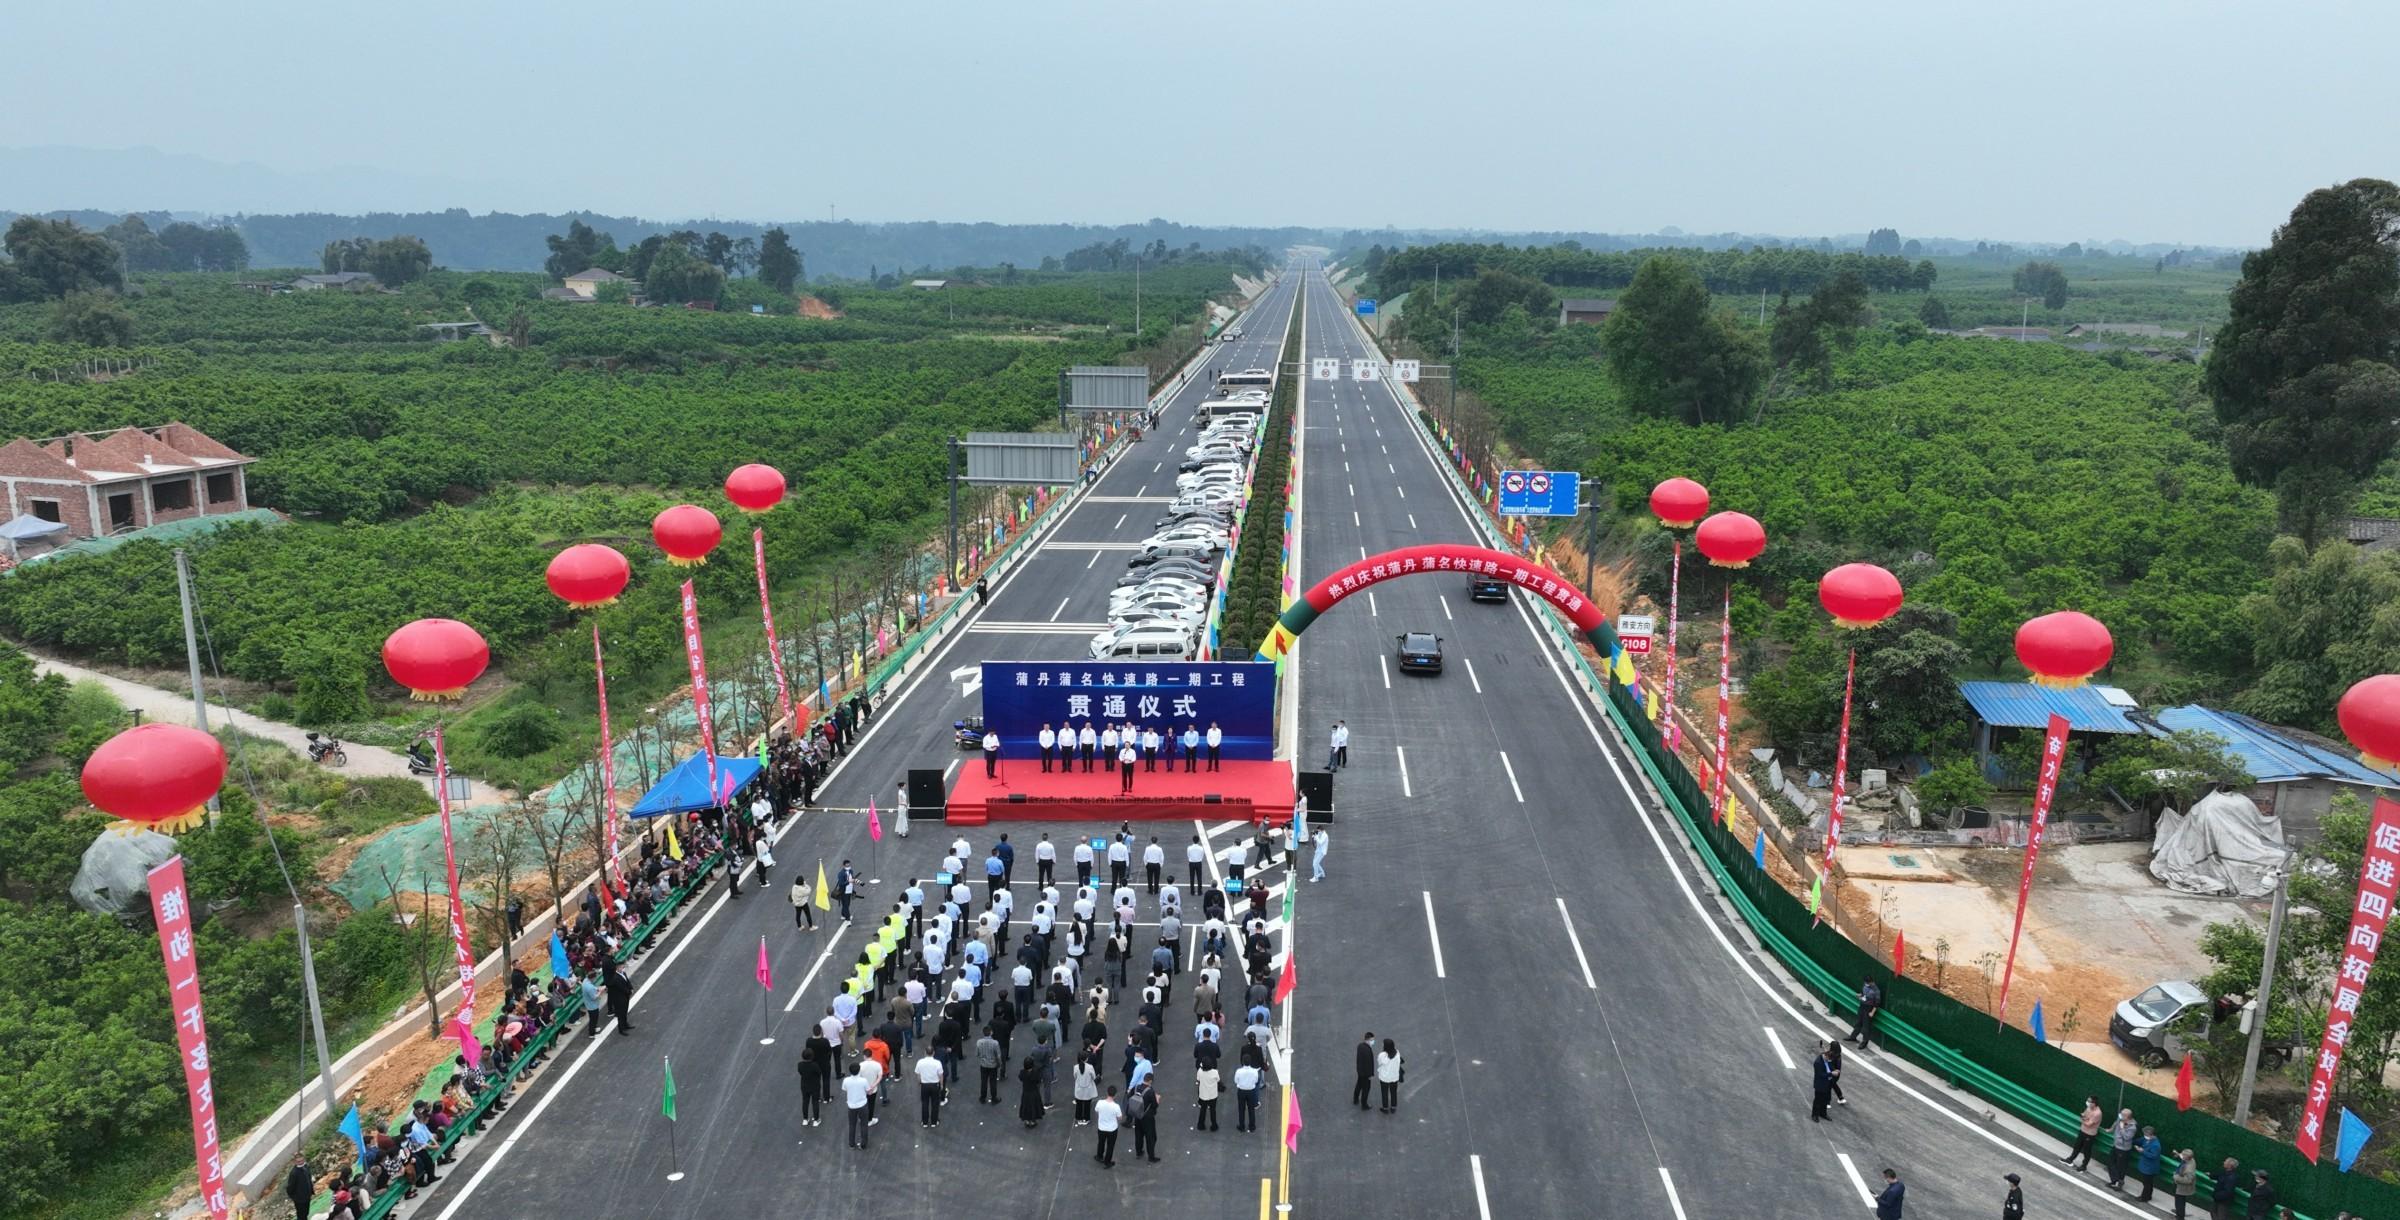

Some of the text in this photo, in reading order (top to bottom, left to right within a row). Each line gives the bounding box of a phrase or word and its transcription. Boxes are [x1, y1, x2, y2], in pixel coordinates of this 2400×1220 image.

[1622, 621, 1651, 630] 雅安方向
[1015, 672, 1246, 686] 蒲丹蒲名快速路一期工程
[1067, 695, 1198, 718] 贯通仪式
